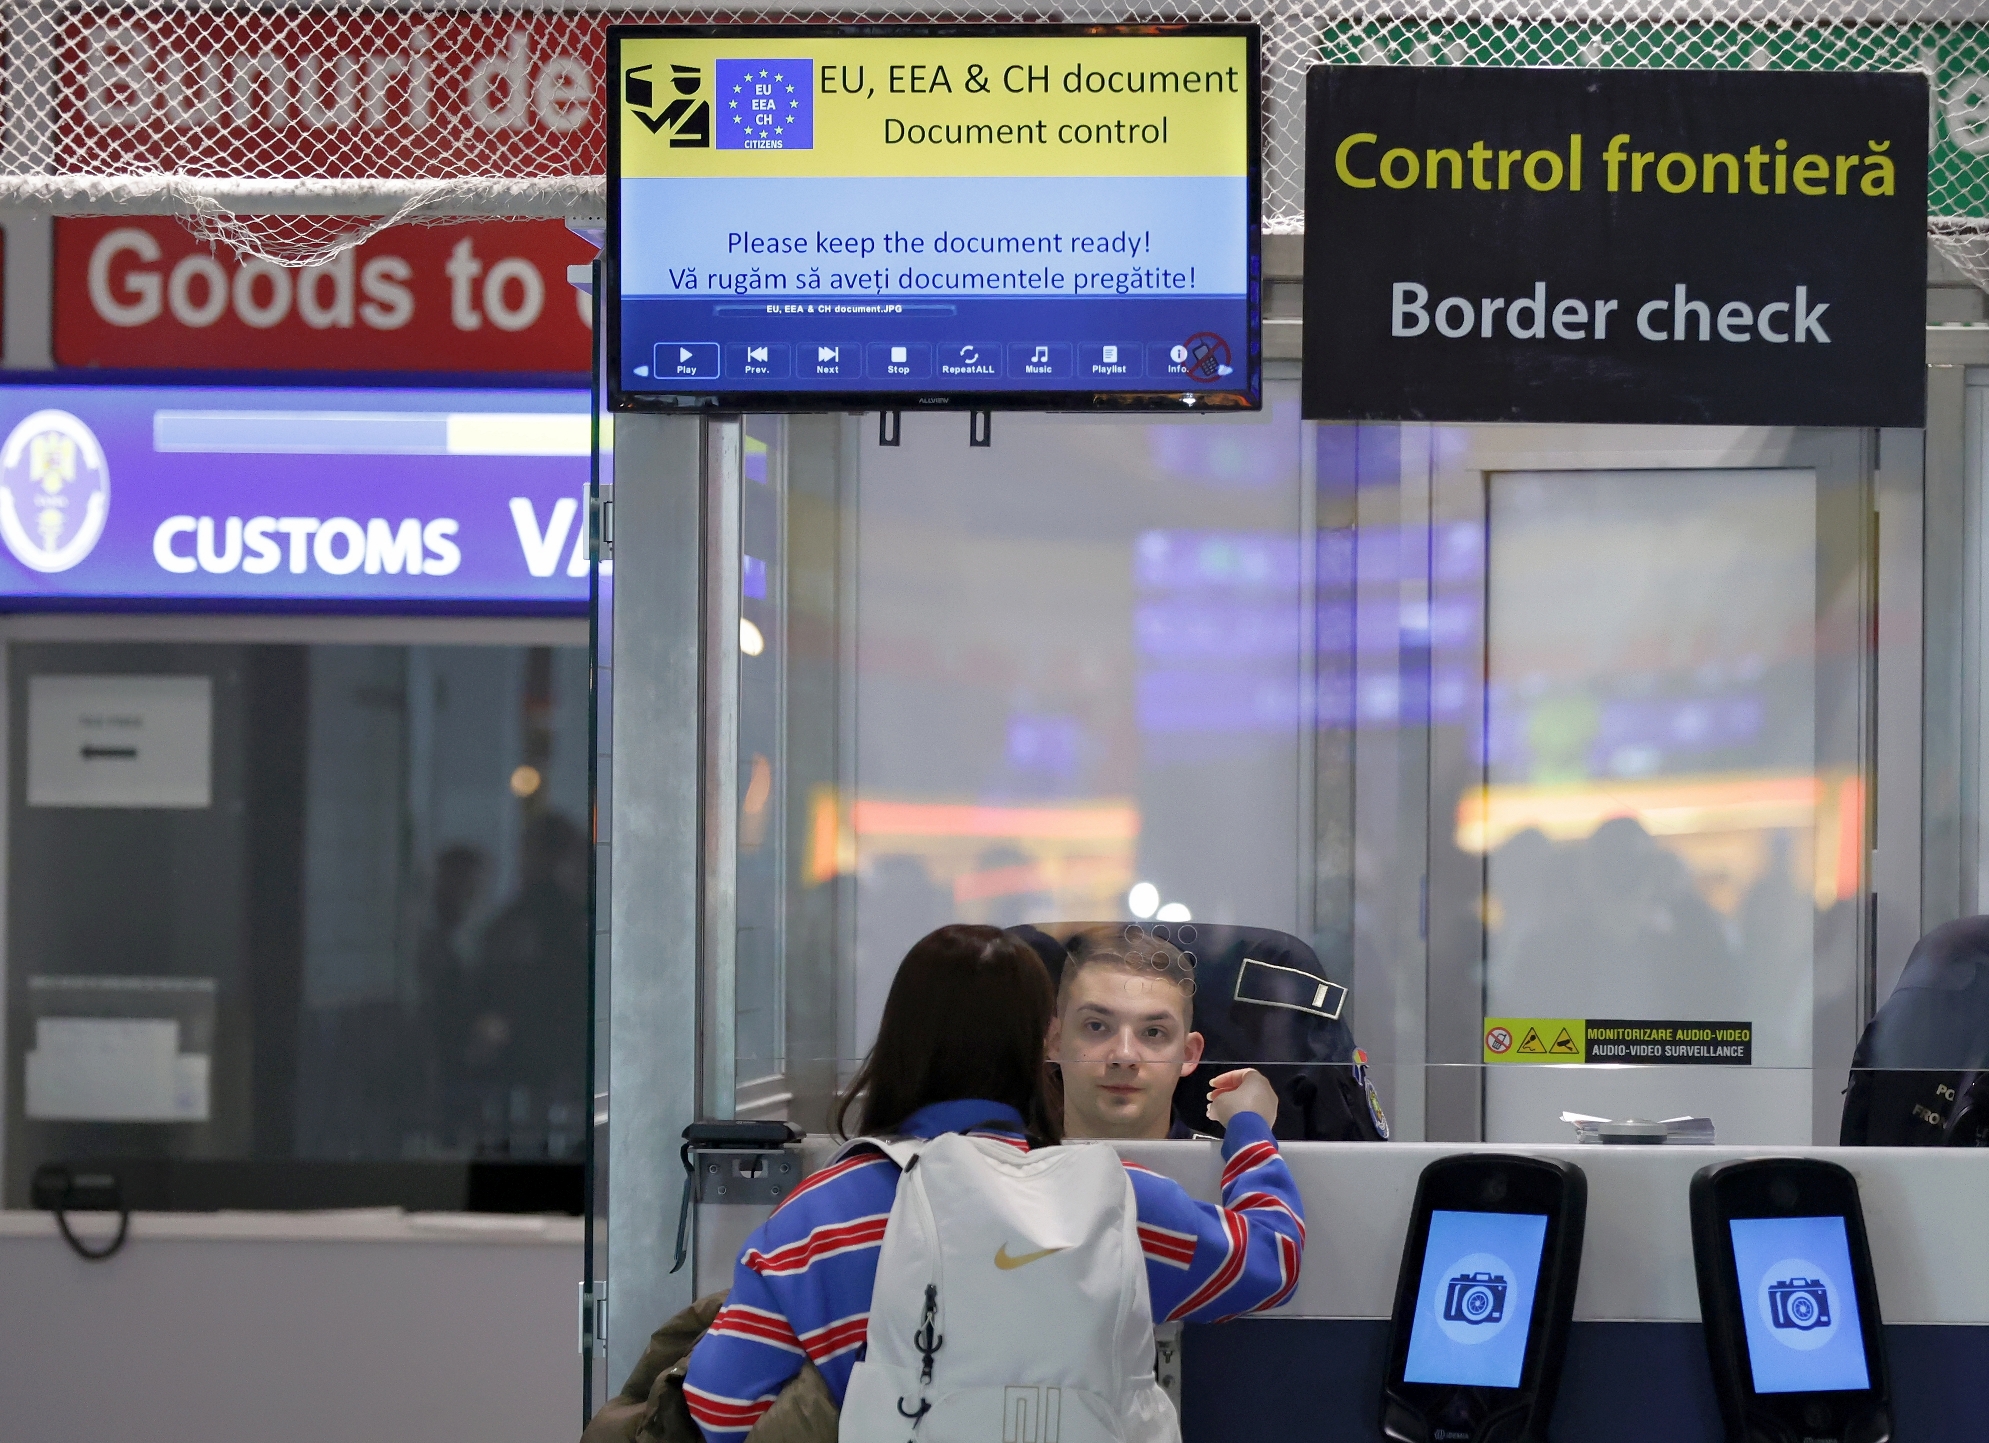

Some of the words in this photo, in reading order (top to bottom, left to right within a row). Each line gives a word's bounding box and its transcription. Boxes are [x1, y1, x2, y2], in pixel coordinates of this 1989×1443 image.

[467, 31, 596, 132] de
[820, 64, 876, 99] EU,
[889, 64, 953, 94] EEA
[964, 64, 991, 94] &
[1002, 64, 1050, 94] CH
[1063, 62, 1239, 94] document
[755, 84, 772, 96] EU
[752, 99, 776, 111] EEA
[755, 114, 773, 126] CH
[885, 117, 1047, 145] Document
[1058, 116, 1167, 145] control
[744, 139, 783, 149] CITIZENS
[1335, 133, 1583, 192] Control
[1603, 134, 1895, 197] frontieră
[728, 231, 808, 253] Please
[816, 231, 875, 258] keep
[883, 231, 925, 253] the
[933, 231, 1063, 253] document
[1071, 231, 1151, 258] ready!
[88, 228, 415, 330] Goods
[446, 236, 545, 332] to
[669, 266, 698, 288] Vă
[707, 266, 788, 295] rugăm
[796, 267, 821, 288] să
[829, 266, 890, 295] aveți
[898, 266, 1065, 289] documentele
[1073, 266, 1197, 295] pregătite!
[766, 305, 782, 314] EU,
[785, 305, 804, 313] EEA
[807, 305, 815, 313] &
[818, 305, 832, 313] CH
[834, 305, 903, 313] document.JPG
[1391, 281, 1618, 341] Border
[1636, 283, 1831, 344] check
[677, 365, 697, 377] Play
[745, 365, 770, 374] Prev.
[817, 366, 839, 374] Next
[887, 365, 910, 376] Stop
[1025, 365, 1052, 374] Music
[1092, 365, 1127, 376] Playlist
[153, 516, 461, 576] CUSTOMS
[1587, 1028, 1673, 1041] MONITORIZARE
[1676, 1029, 1750, 1042] AUDIO-VIDEO
[1592, 1044, 1662, 1057] AUDIO-VIDEO
[1665, 1045, 1744, 1057] SURVEILLANCE
